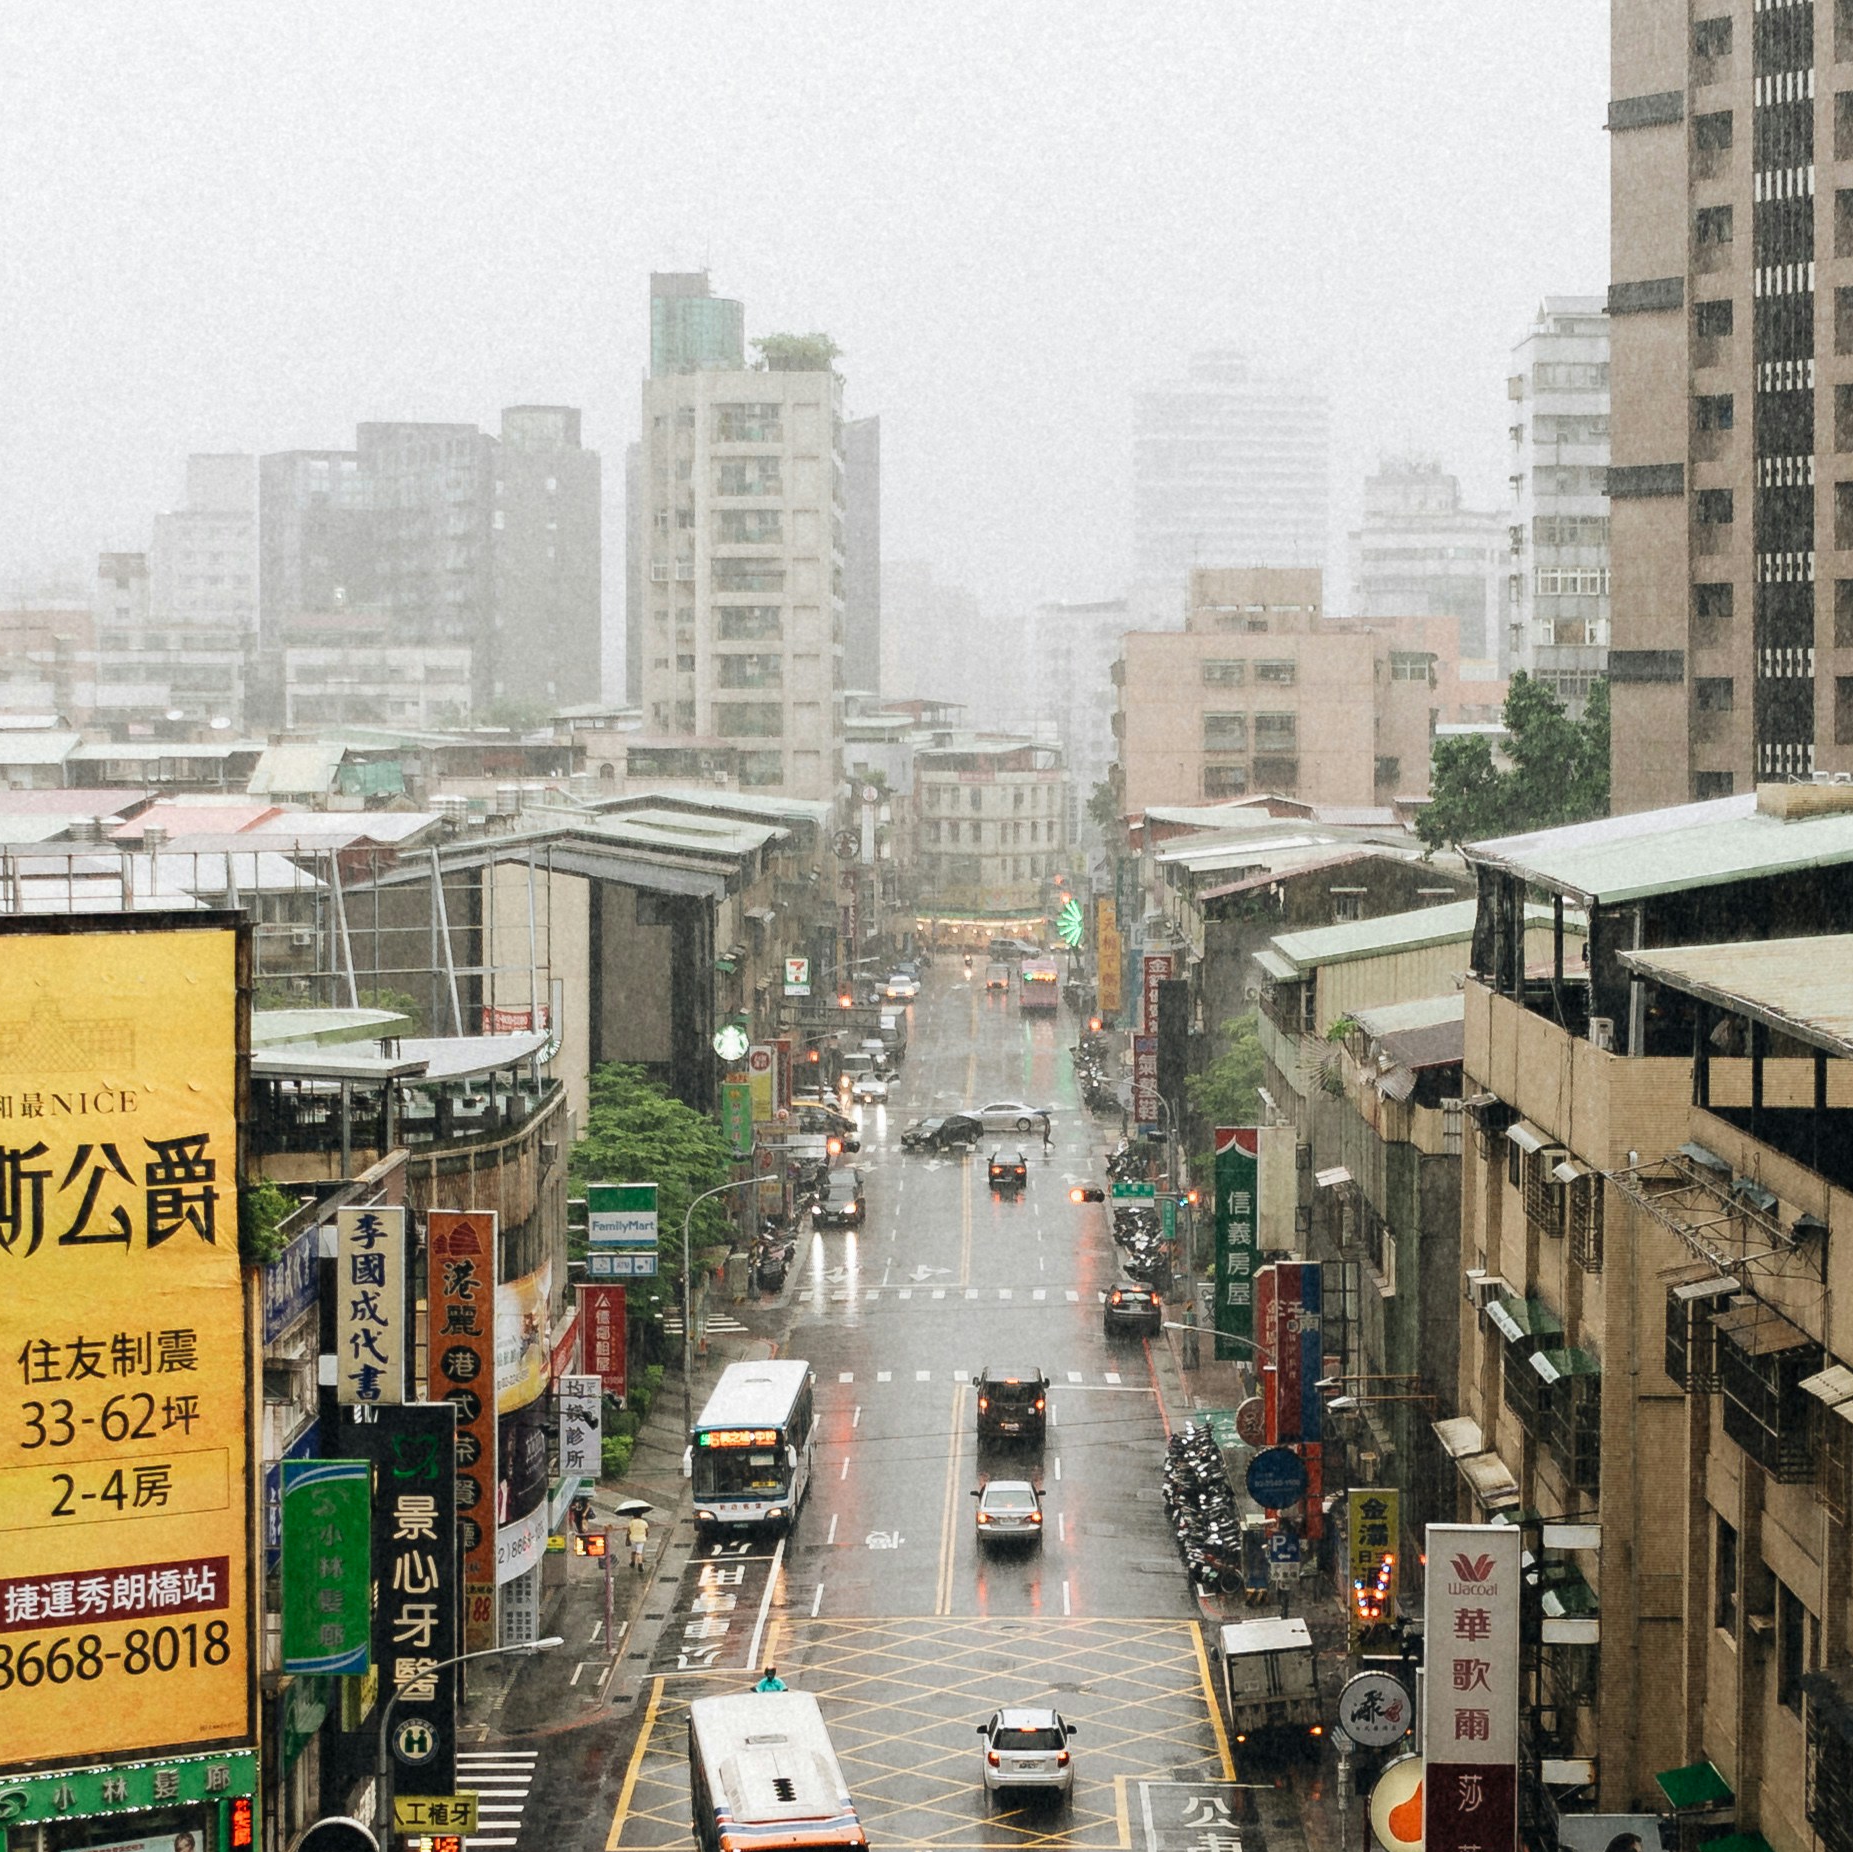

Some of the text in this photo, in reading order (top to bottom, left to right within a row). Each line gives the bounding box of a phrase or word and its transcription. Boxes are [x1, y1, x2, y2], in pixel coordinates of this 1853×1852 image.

[592, 1221, 654, 1233] FamilyMart
[1227, 1191, 1251, 1305] 信義房屋
[349, 1214, 388, 1400] 李國成代書
[17, 1328, 199, 1385] 住友制震
[20, 1392, 200, 1449] 33-62坪
[50, 1464, 173, 1517] 2-4房
[1272, 1536, 1286, 1552] P
[4, 1565, 217, 1624] 捷運秀朗橋站
[393, 1496, 439, 1701] 景心牙醫
[1448, 1583, 1498, 1596] Wacoal
[1453, 1608, 1492, 1741] 華歌爾
[53, 1762, 231, 1811] 小林髮廊
